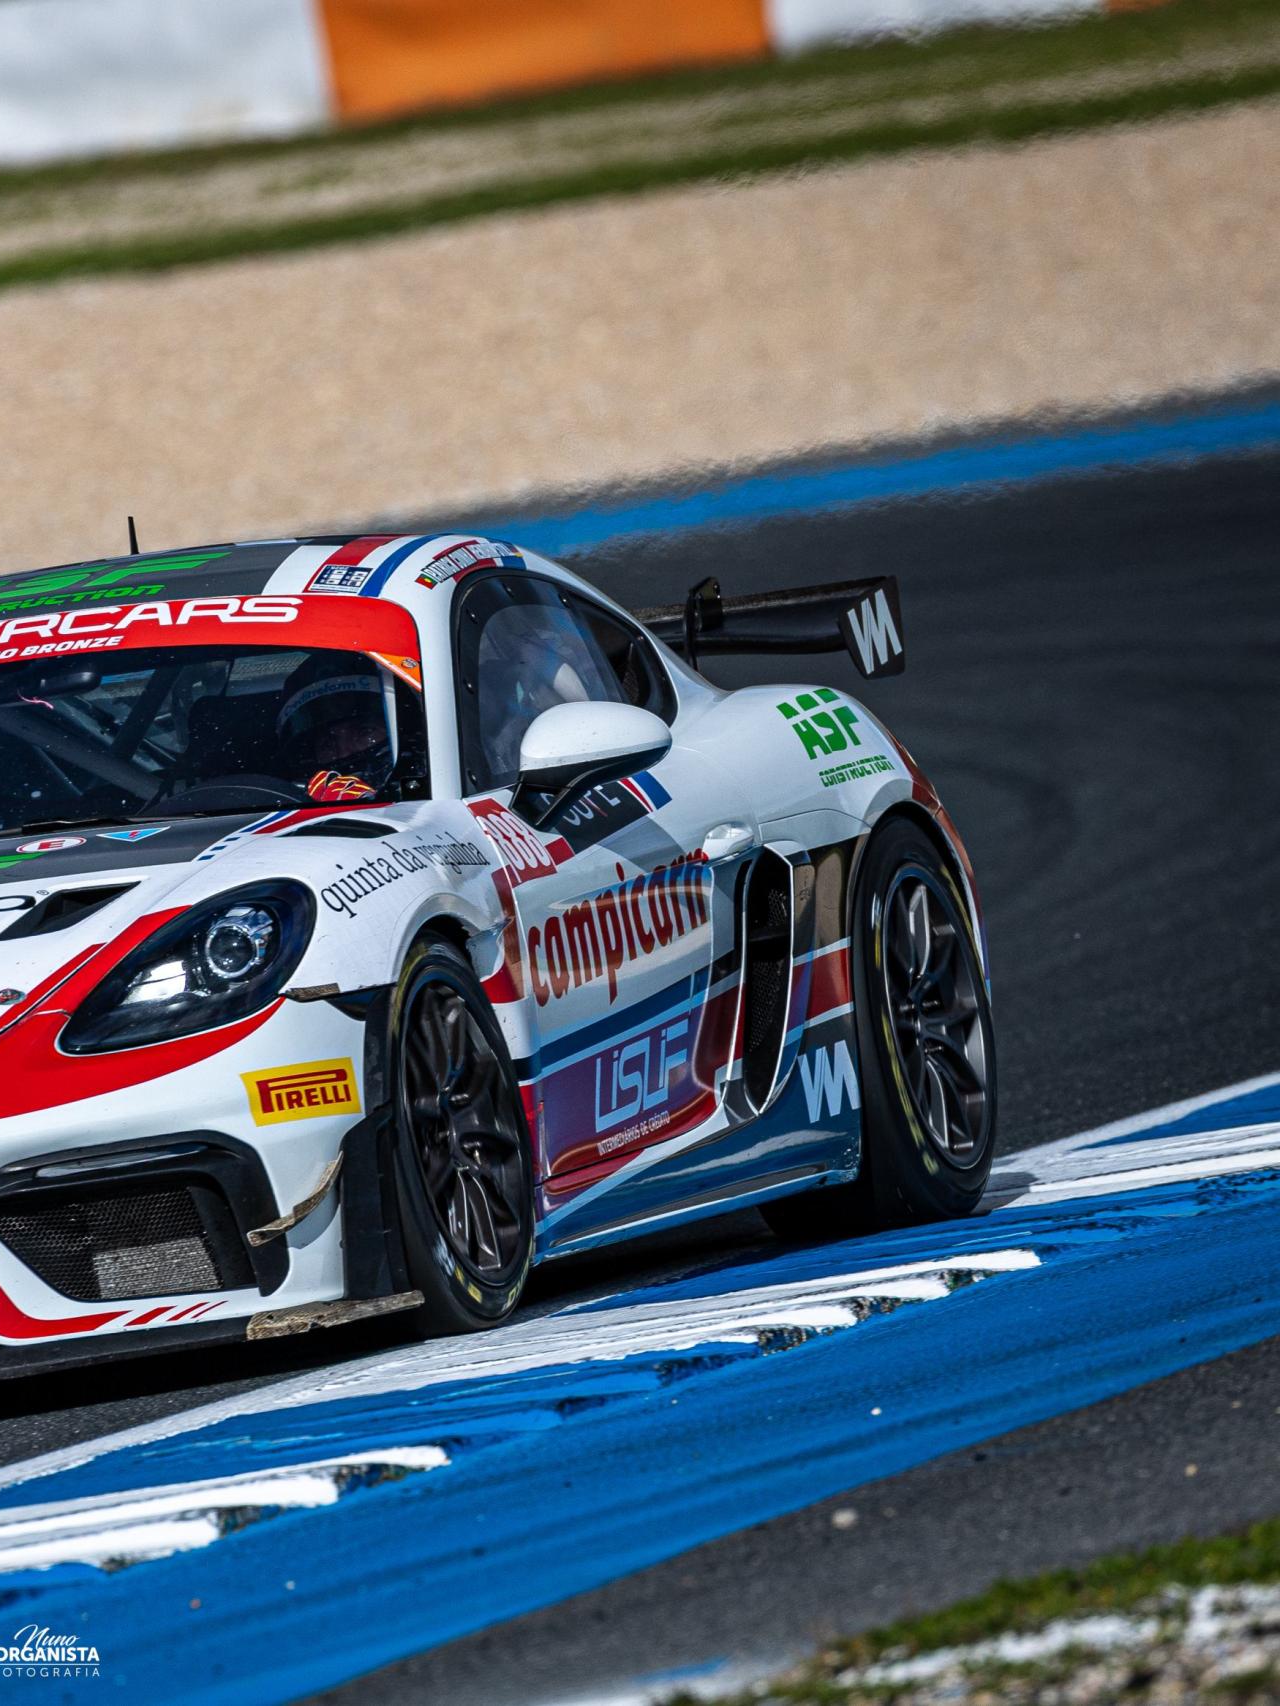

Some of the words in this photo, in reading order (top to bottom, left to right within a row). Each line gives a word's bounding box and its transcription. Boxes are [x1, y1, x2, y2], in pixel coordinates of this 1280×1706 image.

[20, 635, 124, 657] BRONZE
[321, 857, 403, 918] quinta
[381, 841, 427, 873] da
[528, 848, 709, 1007] campicarn
[255, 1068, 352, 1114] PIRELLI
